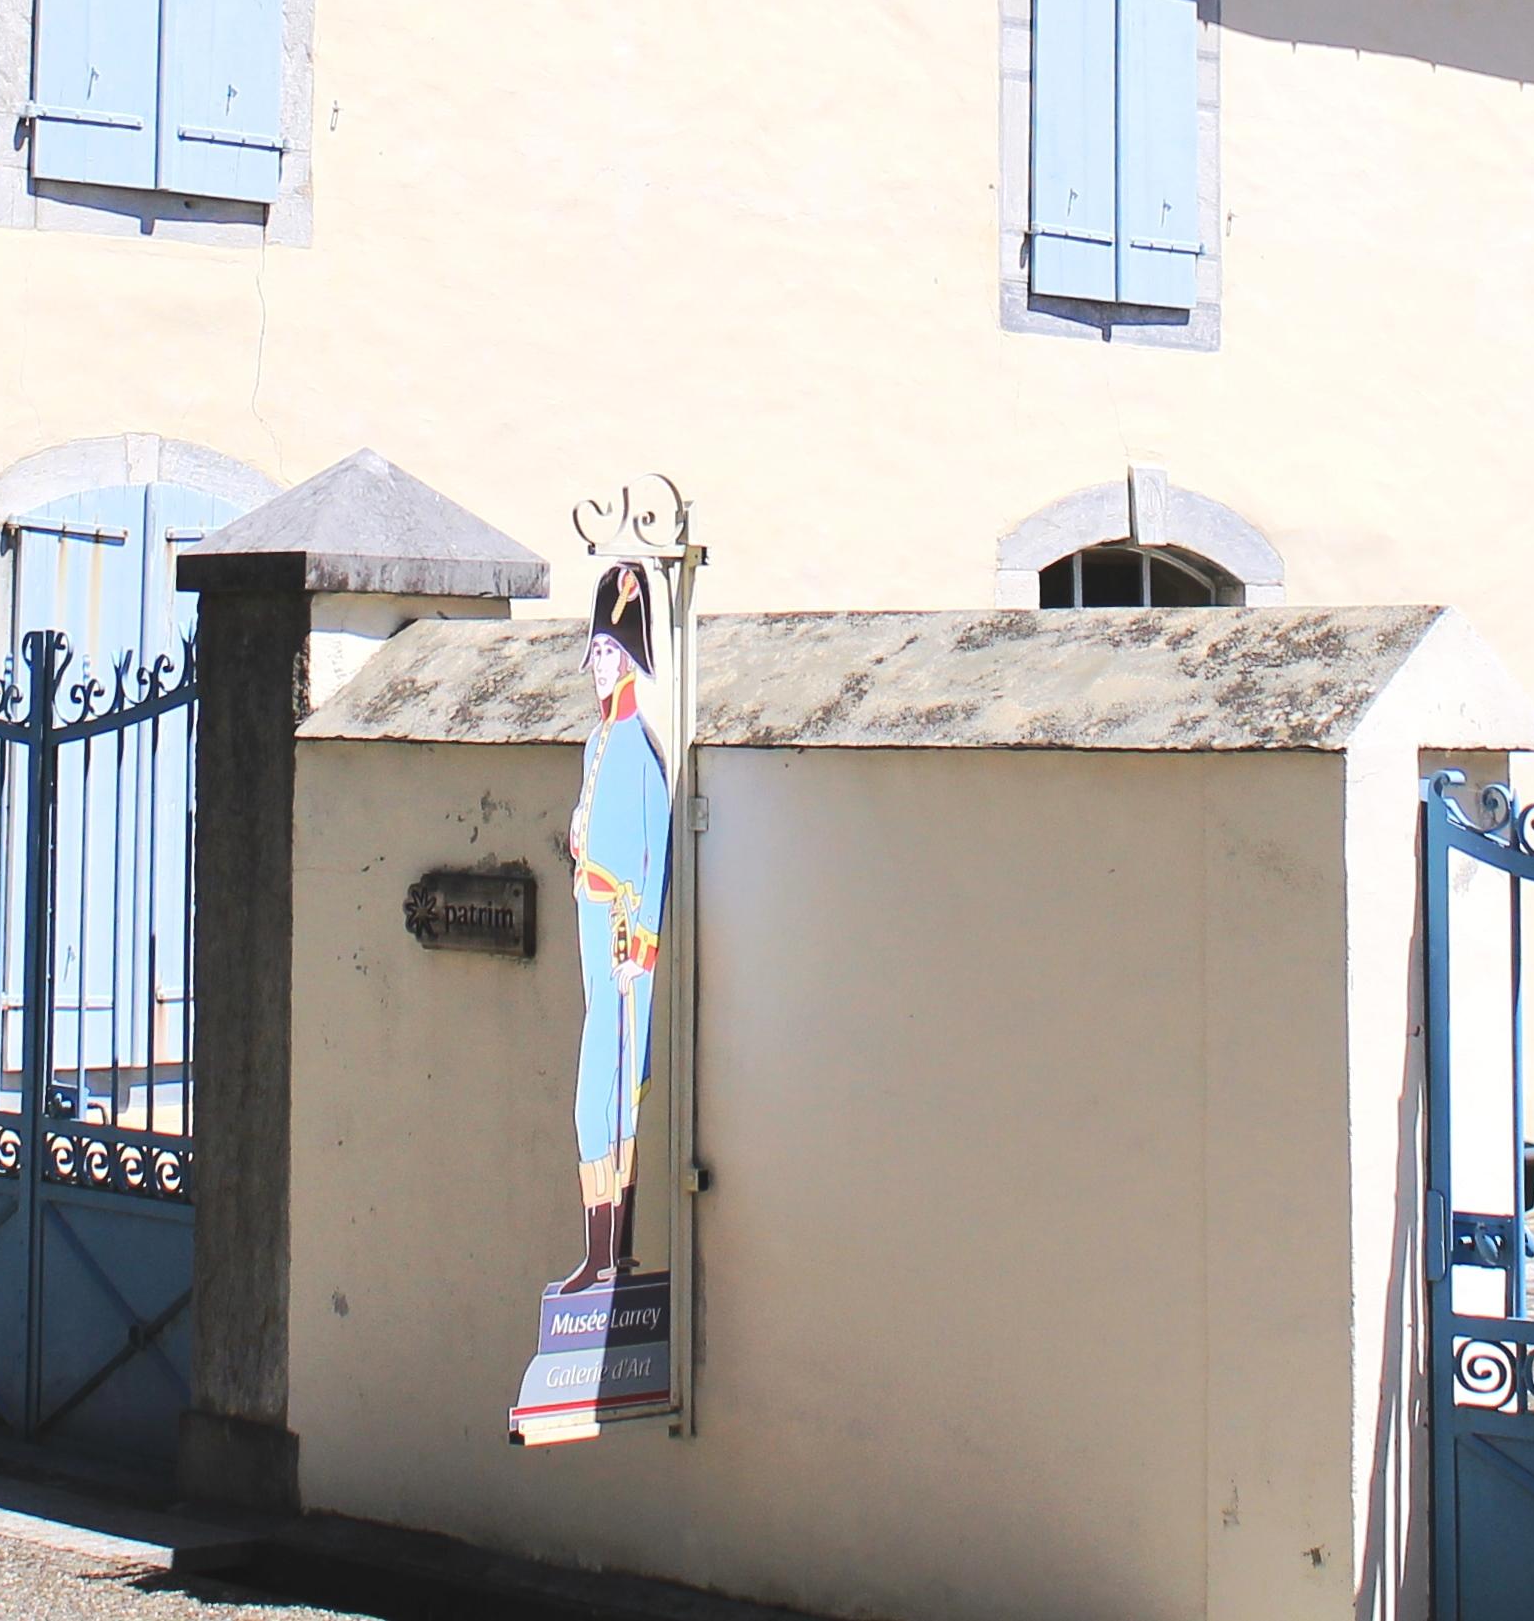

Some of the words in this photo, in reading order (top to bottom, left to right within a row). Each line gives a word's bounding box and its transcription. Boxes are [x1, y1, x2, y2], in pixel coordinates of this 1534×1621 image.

[444, 900, 514, 933] patrim
[551, 1309, 607, 1336] Musée
[610, 1306, 662, 1331] Larrey
[547, 1363, 608, 1388] Galerie
[611, 1356, 652, 1380] d'Art
